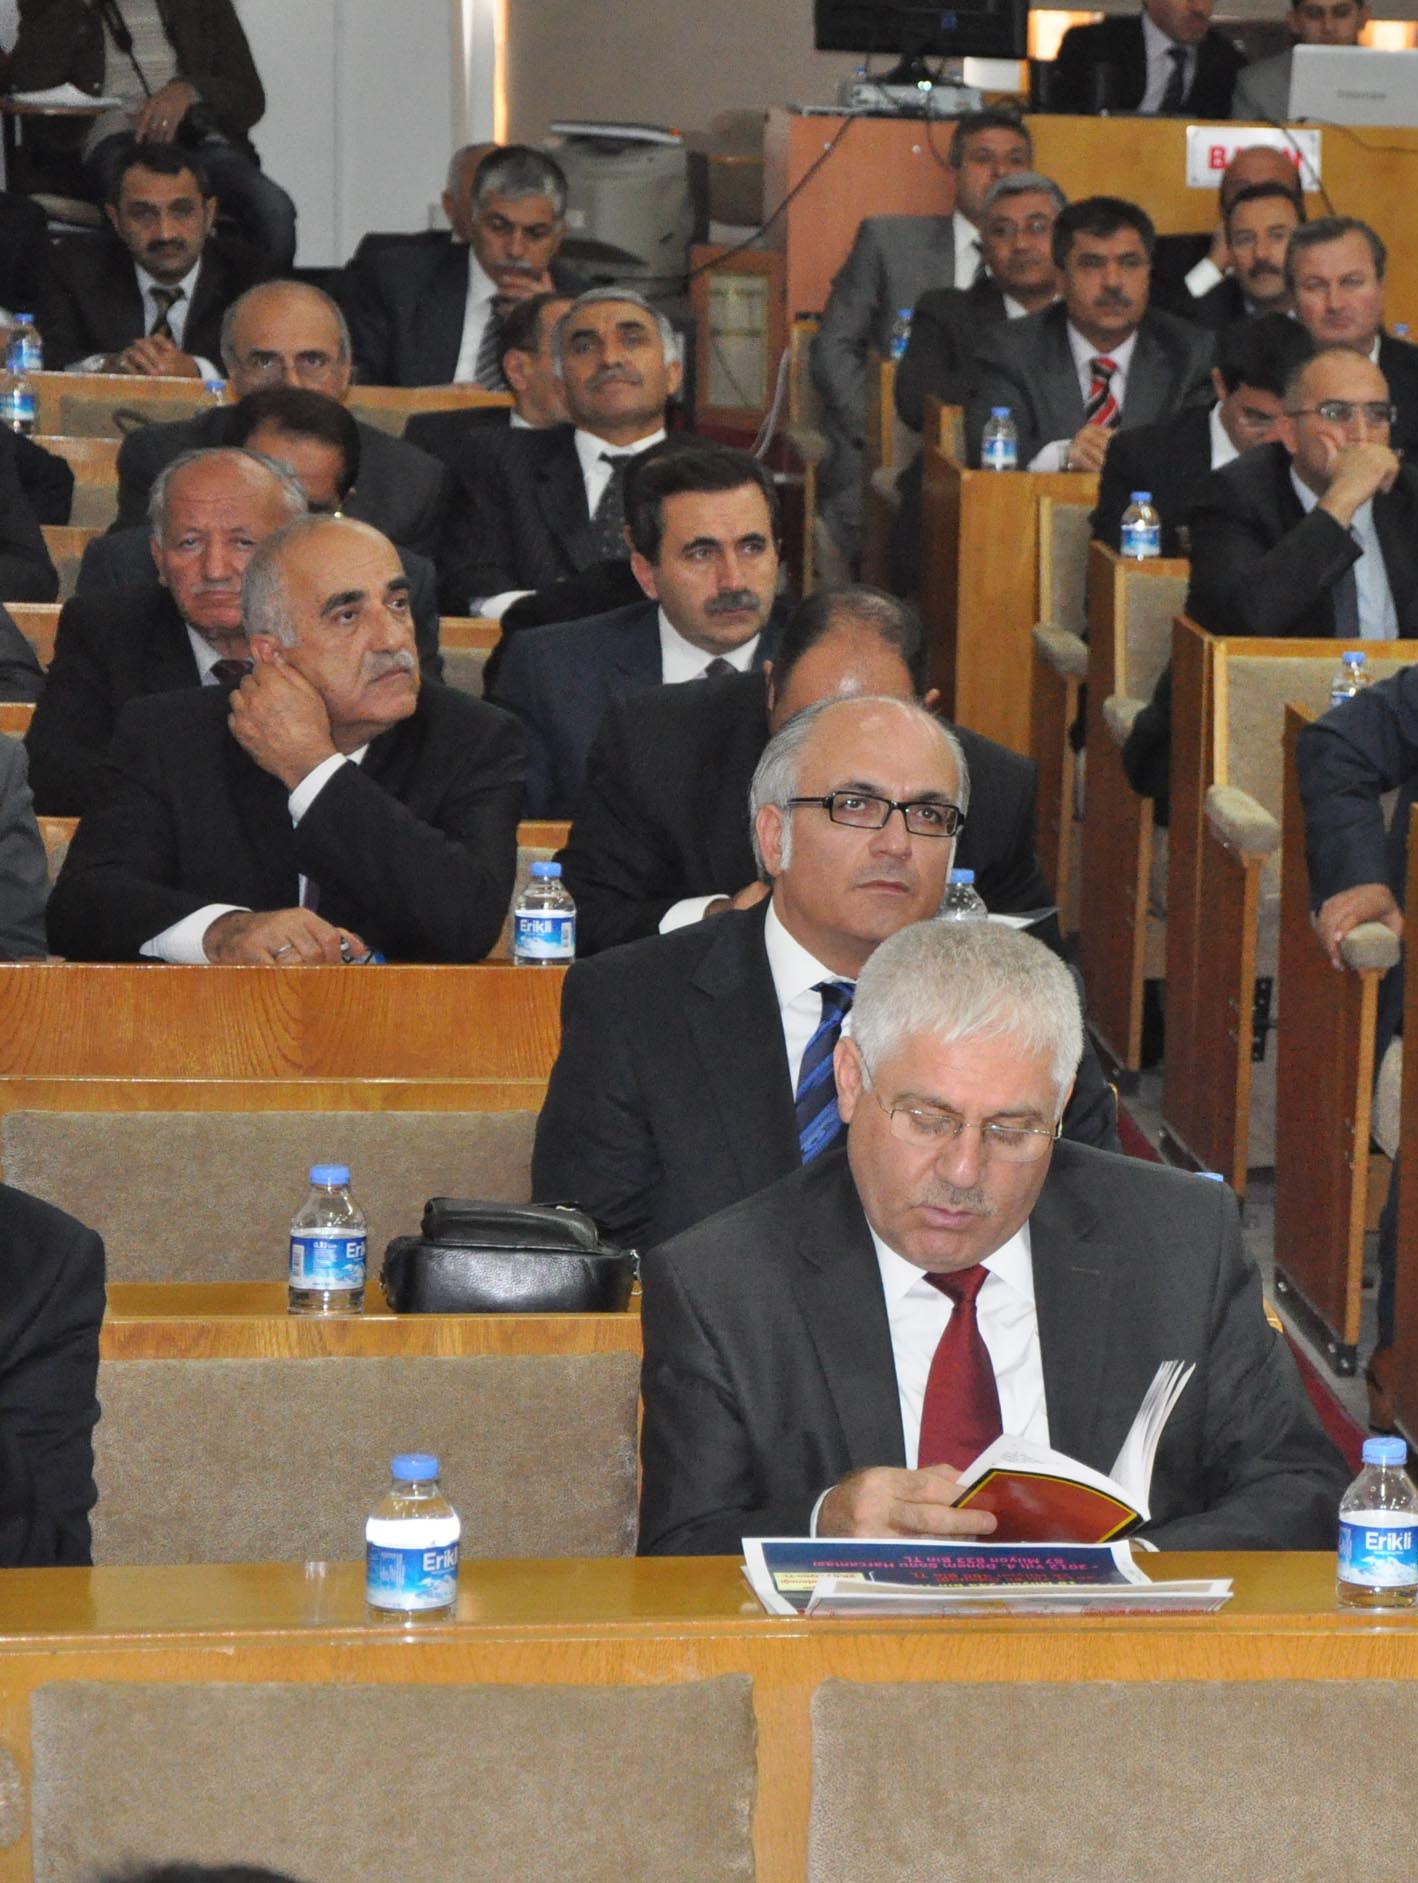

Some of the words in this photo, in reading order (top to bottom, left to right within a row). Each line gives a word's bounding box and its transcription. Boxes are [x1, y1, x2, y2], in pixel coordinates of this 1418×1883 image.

[520, 919, 552, 933] Erikli
[346, 1241, 365, 1259] Eri
[1365, 1531, 1412, 1551] Erikli
